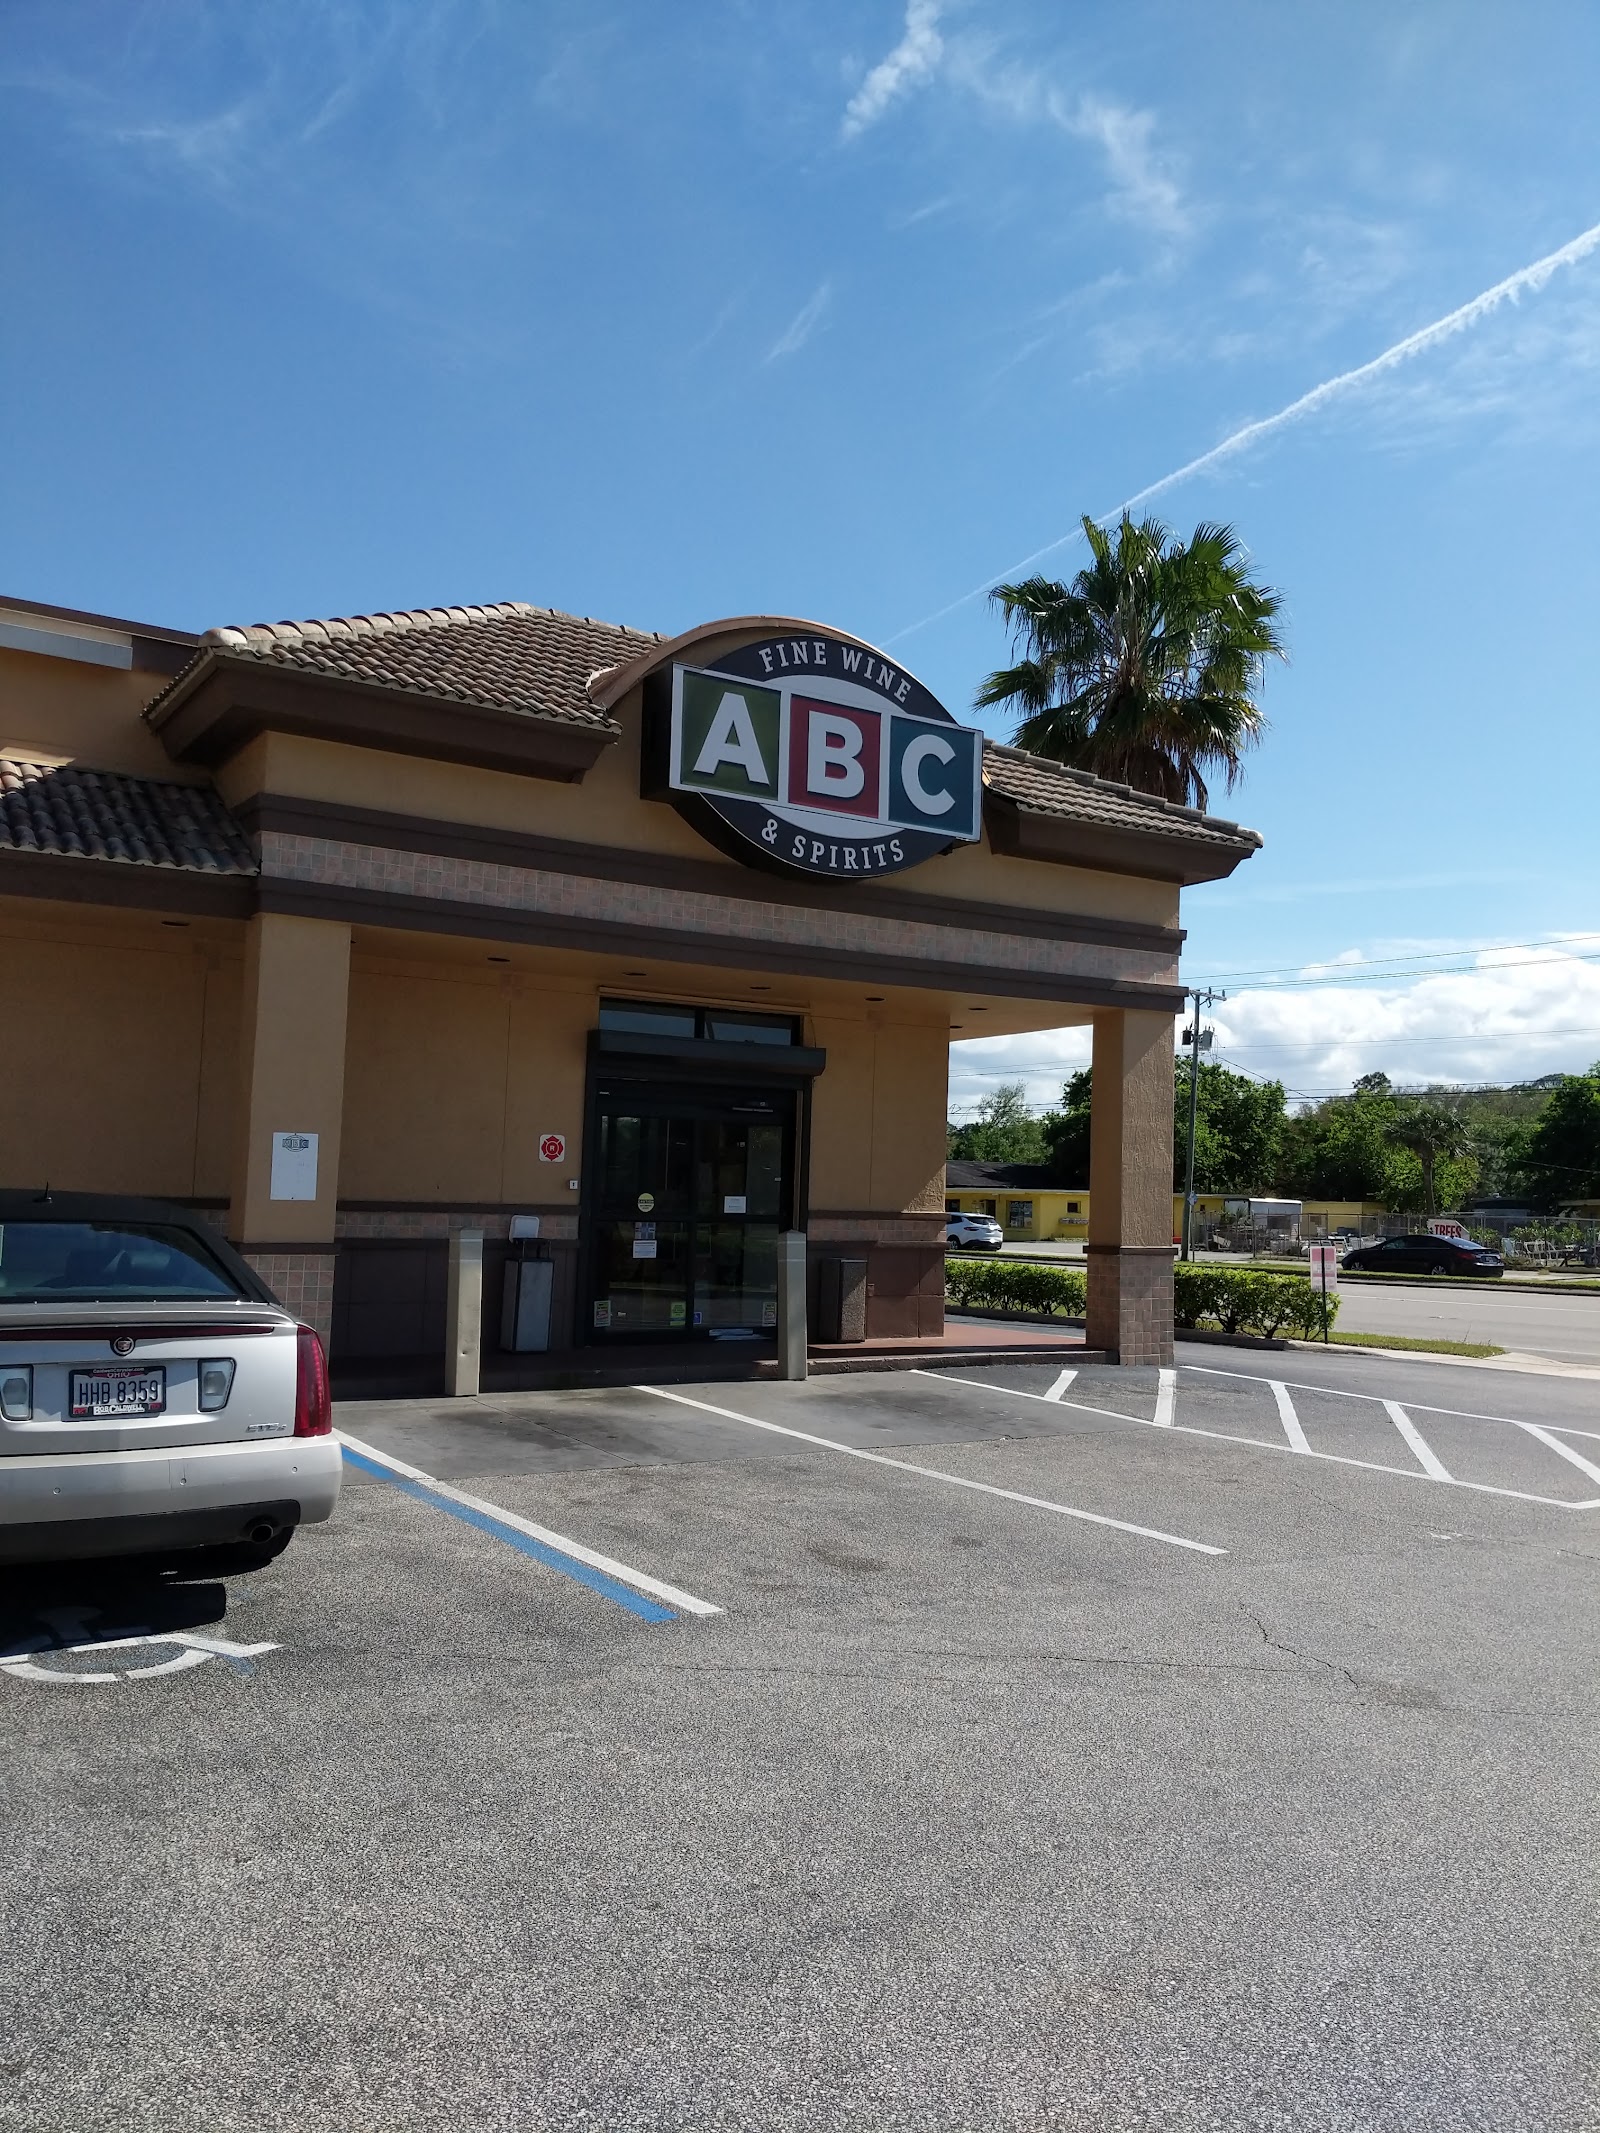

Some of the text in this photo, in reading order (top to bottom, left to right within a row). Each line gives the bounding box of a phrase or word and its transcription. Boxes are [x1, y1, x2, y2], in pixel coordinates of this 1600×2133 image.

[759, 640, 913, 704] FINE WINE
[692, 691, 957, 817] ABC
[761, 818, 905, 870] & SPIRITS
[1434, 1224, 1462, 1239] TREES
[79, 1379, 159, 1406] HHB 8359
[110, 1403, 145, 1415] CALDWELL
